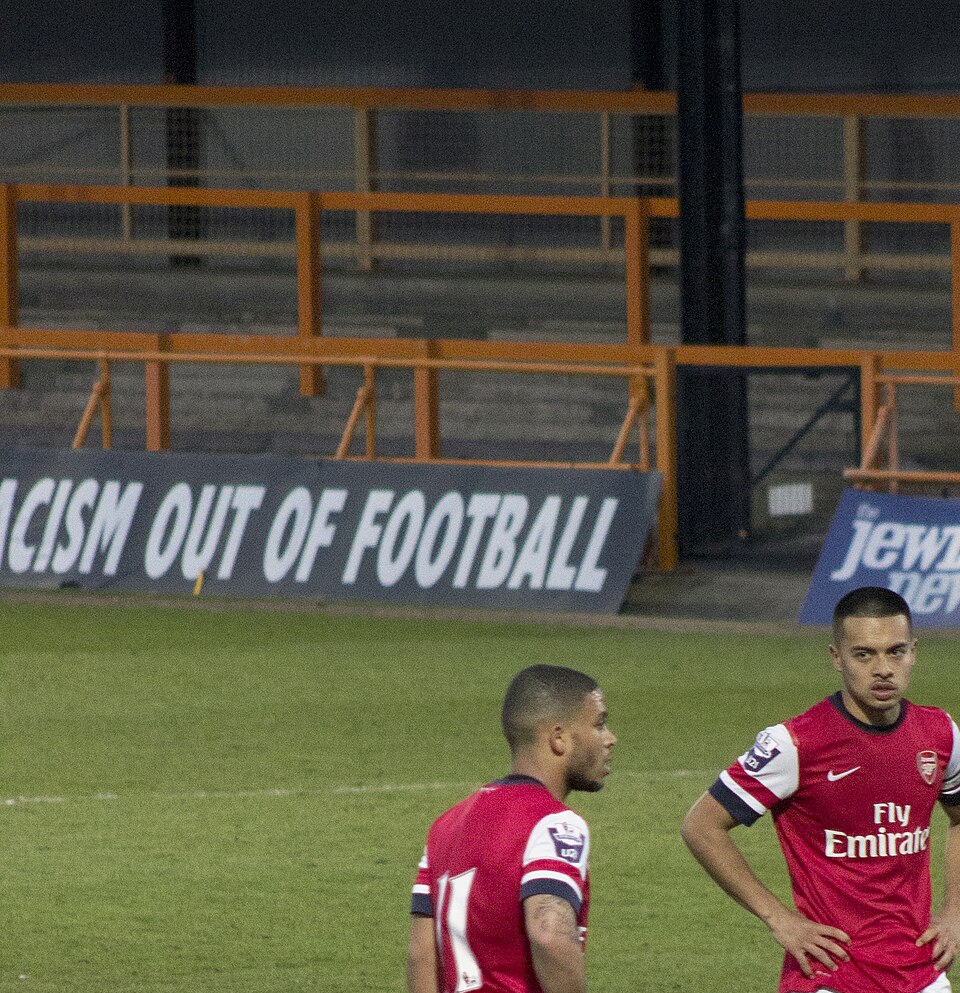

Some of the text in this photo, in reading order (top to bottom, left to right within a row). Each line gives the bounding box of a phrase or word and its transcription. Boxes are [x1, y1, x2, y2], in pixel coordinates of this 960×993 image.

[144, 483, 266, 582] OUT
[262, 486, 348, 584] OF
[342, 490, 619, 593] FOOTBALL
[874, 802, 911, 827] Fly
